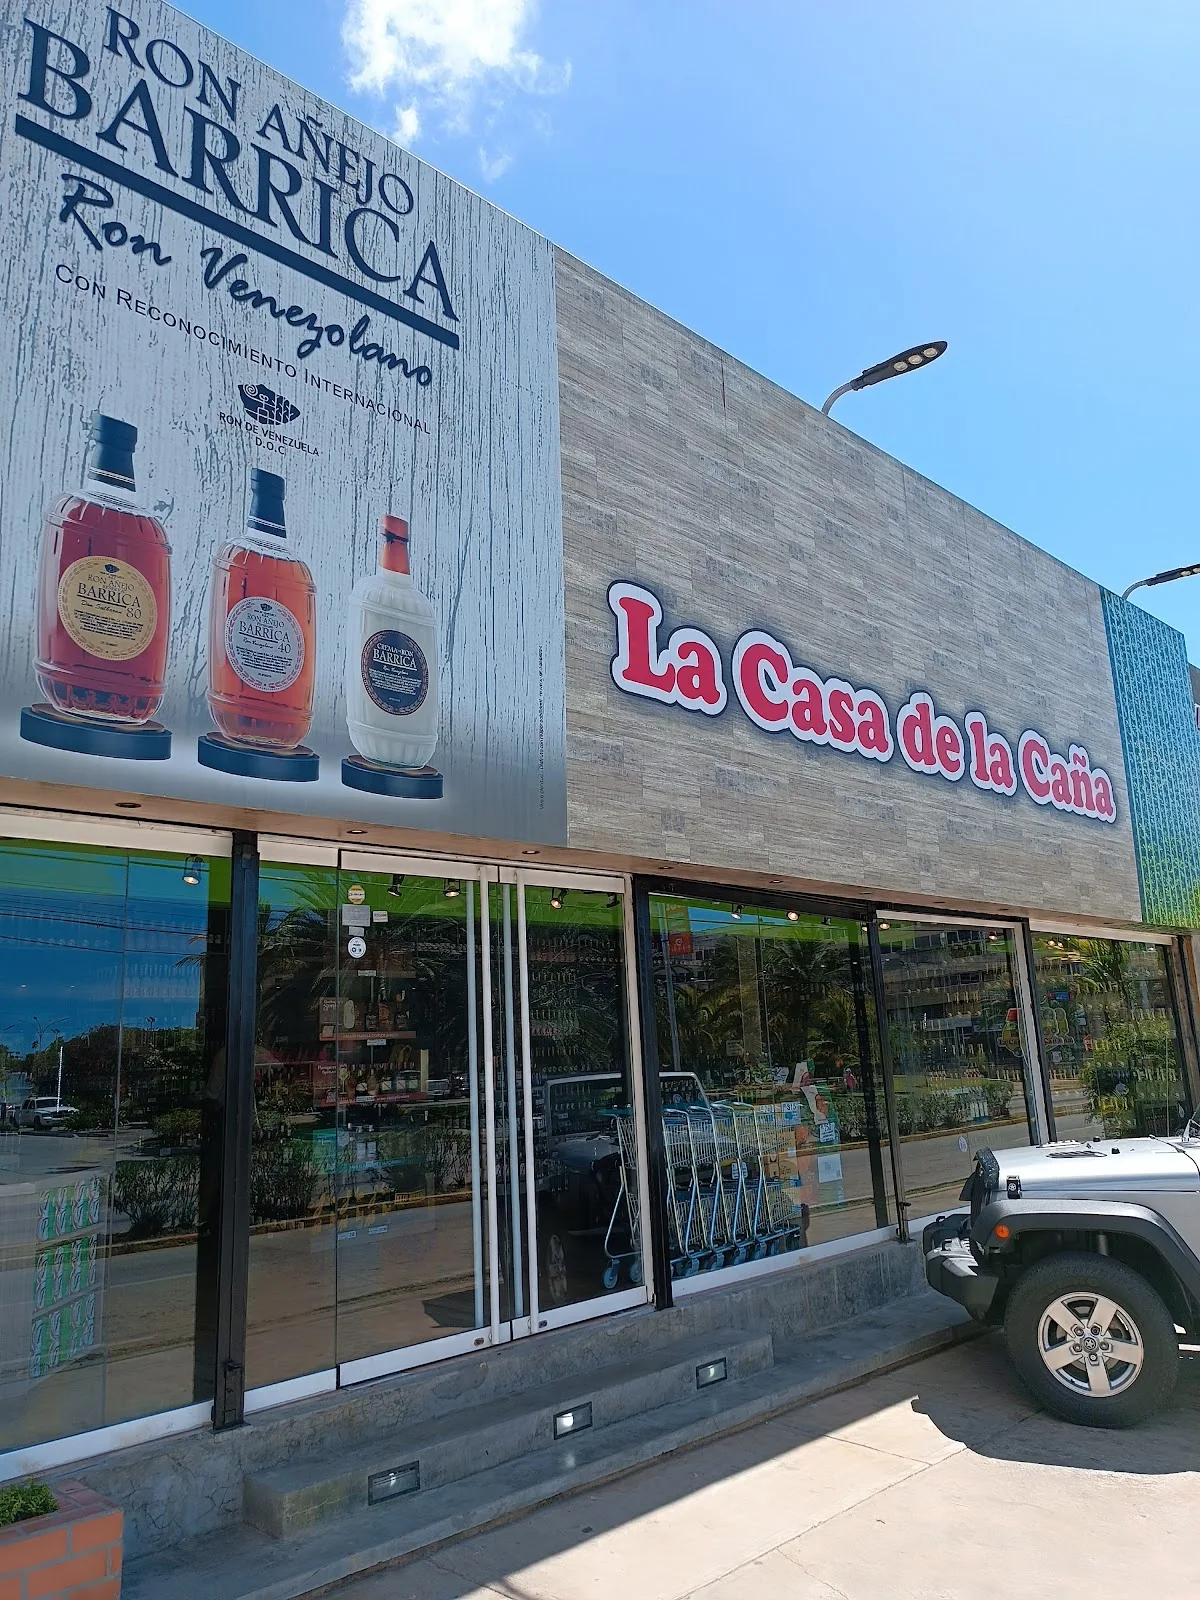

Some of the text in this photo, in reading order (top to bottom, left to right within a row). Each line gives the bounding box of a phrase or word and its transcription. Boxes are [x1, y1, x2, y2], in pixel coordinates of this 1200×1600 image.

[104, 6, 415, 216] RON AÑEJO
[17, 17, 460, 322] BARRICA
[59, 173, 432, 387] Ron Venezolano
[55, 264, 431, 435] CON RECONOCIMIENTO INTERNACIONAL
[219, 411, 320, 457] RON DE VENEZUELA
[77, 582, 141, 608] BARRICA
[87, 573, 107, 585] RON
[126, 607, 142, 620] 80
[239, 620, 291, 644] BARRICA
[277, 642, 292, 654] 40
[373, 647, 418, 669] BARRICA
[615, 594, 723, 708] La
[736, 640, 892, 756] Casa
[900, 699, 963, 776] de
[967, 718, 1015, 791] la
[1019, 736, 1116, 819] Caña
